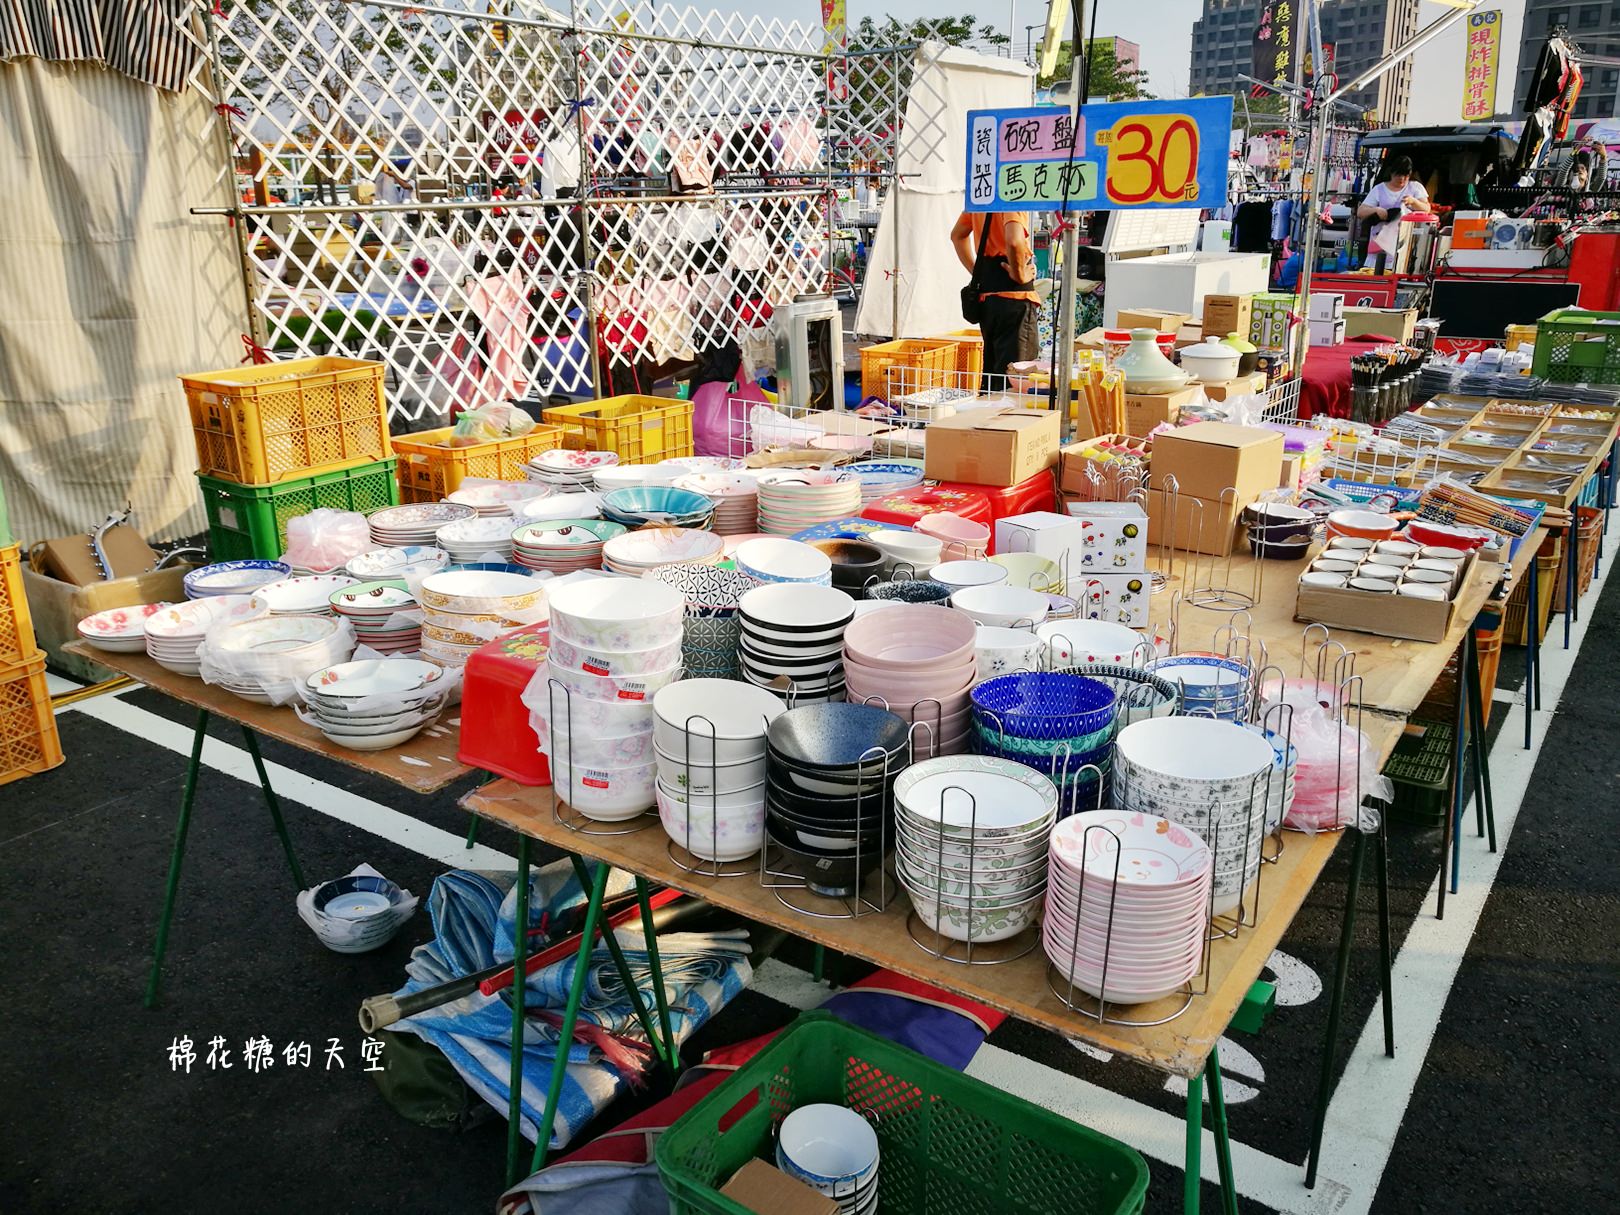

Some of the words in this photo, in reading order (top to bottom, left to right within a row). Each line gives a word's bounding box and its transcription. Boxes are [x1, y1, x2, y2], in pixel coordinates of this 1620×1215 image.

[1465, 28, 1494, 116] 現炸排骨酥
[1004, 115, 1076, 153] 碗盤
[973, 127, 992, 198] 瓷器
[1004, 163, 1086, 201] 馬克杯
